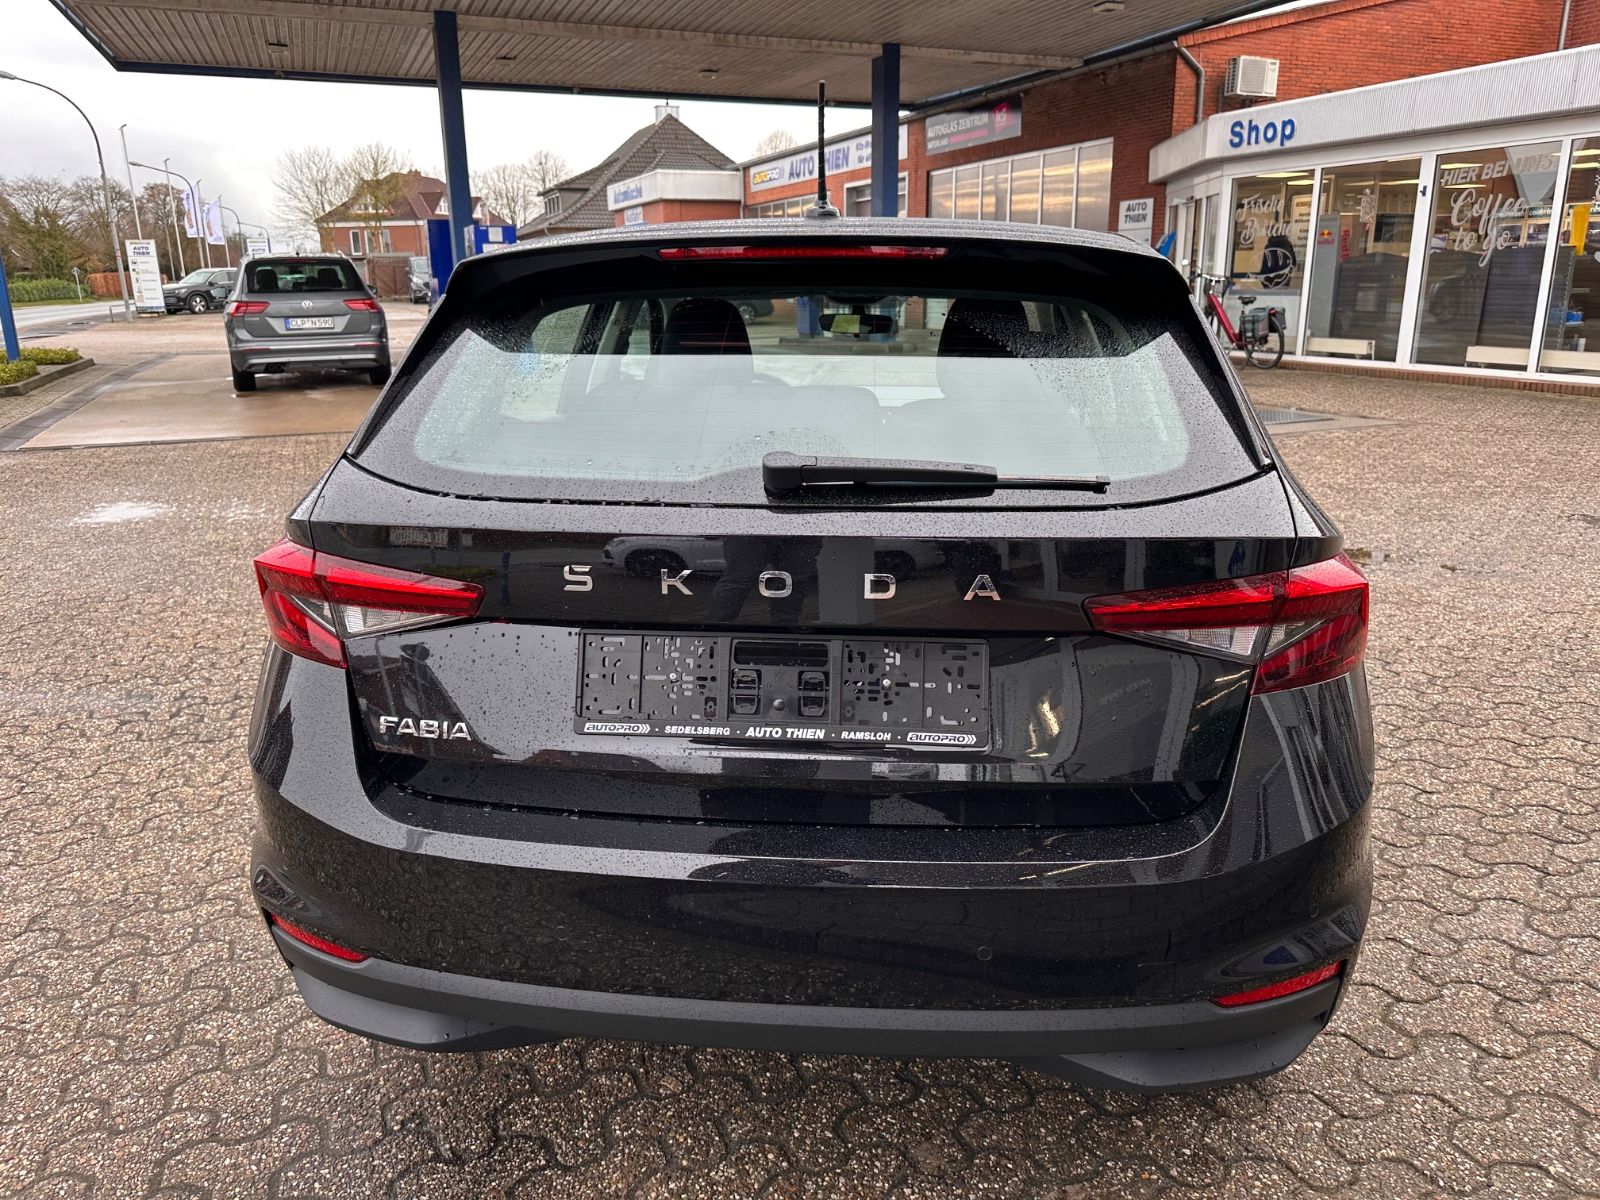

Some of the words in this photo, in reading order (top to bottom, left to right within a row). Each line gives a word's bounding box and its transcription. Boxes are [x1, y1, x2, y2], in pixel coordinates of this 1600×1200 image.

[927, 120, 957, 138] AUTOGLAS
[958, 112, 989, 130] ZENTRUM
[1229, 118, 1295, 148] Shop
[788, 155, 815, 181] AUTO
[823, 146, 850, 172] HIEN
[1440, 168, 1479, 187] HIER
[1481, 160, 1510, 180] BEI
[1511, 154, 1554, 175] UNS
[1124, 212, 1148, 224] THIEN
[1125, 202, 1147, 212] AUTO
[1236, 192, 1284, 222] Frische
[1451, 188, 1530, 235] Coffee
[1240, 217, 1297, 244] Brötche
[1454, 226, 1477, 250] to
[1479, 231, 1513, 267] go
[379, 715, 472, 741] FABIA
[664, 725, 731, 735] SEDELSBERG
[745, 727, 782, 738] AUTO
[786, 727, 825, 739] THIEN
[841, 731, 892, 741] RAMSLOH
